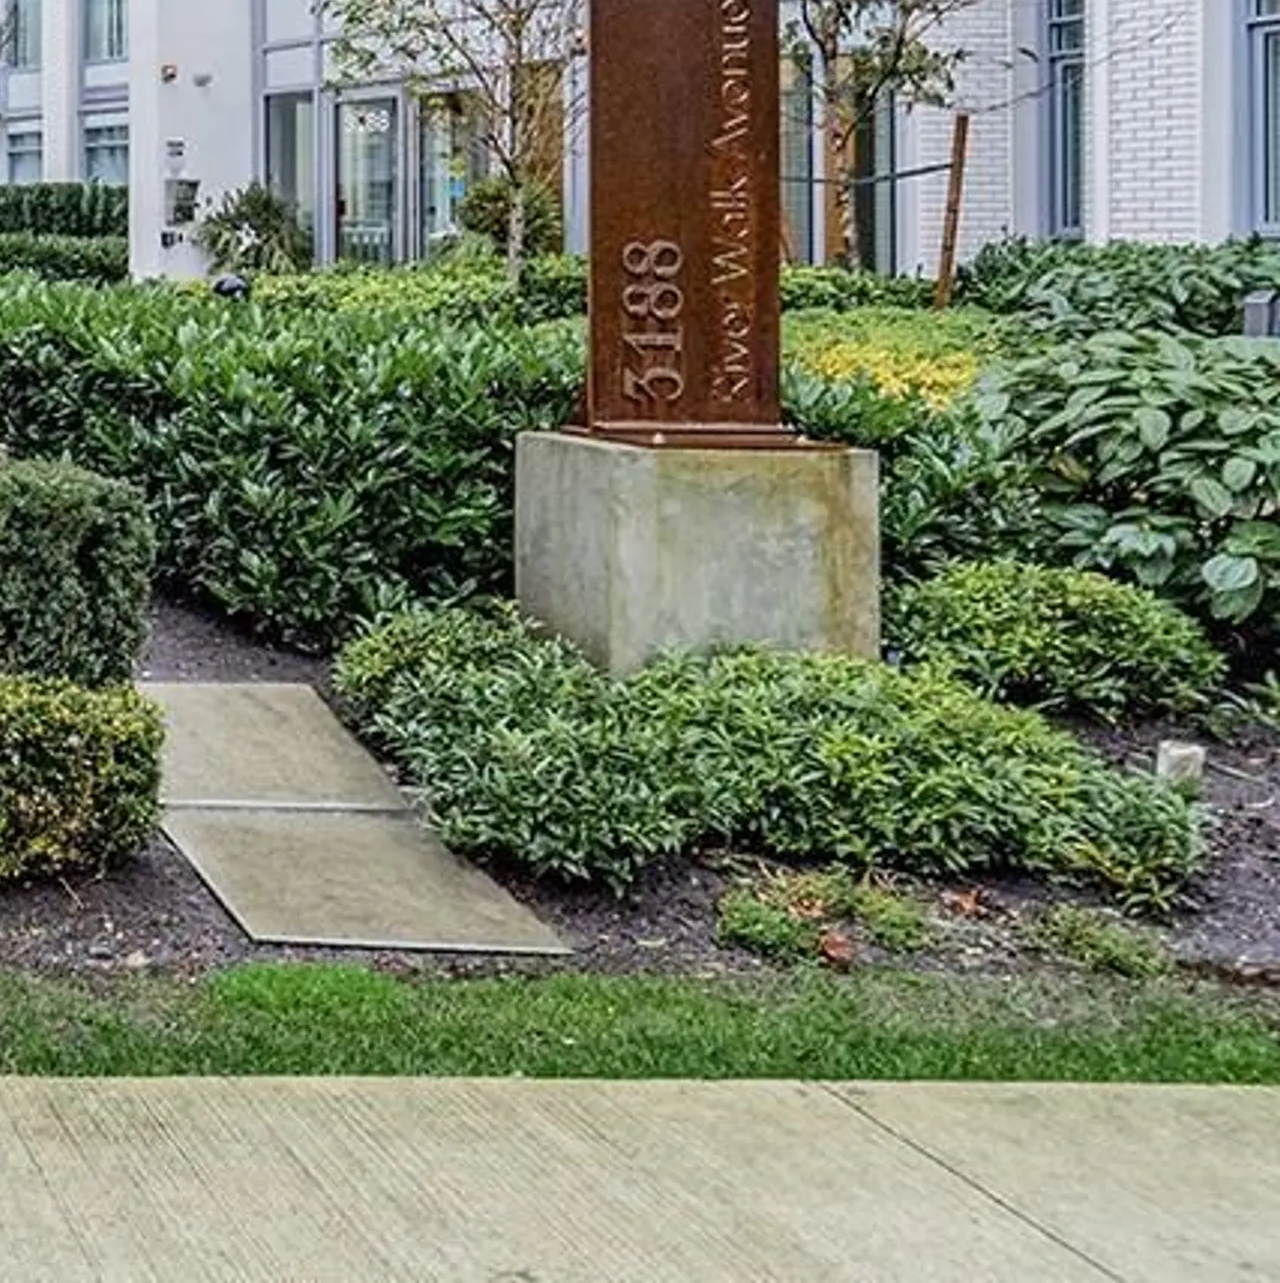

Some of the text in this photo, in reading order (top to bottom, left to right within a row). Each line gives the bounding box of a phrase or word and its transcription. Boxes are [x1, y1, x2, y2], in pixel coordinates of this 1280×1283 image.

[708, 175, 749, 285] Walk
[621, 238, 684, 402] 3188
[711, 301, 751, 403] River
